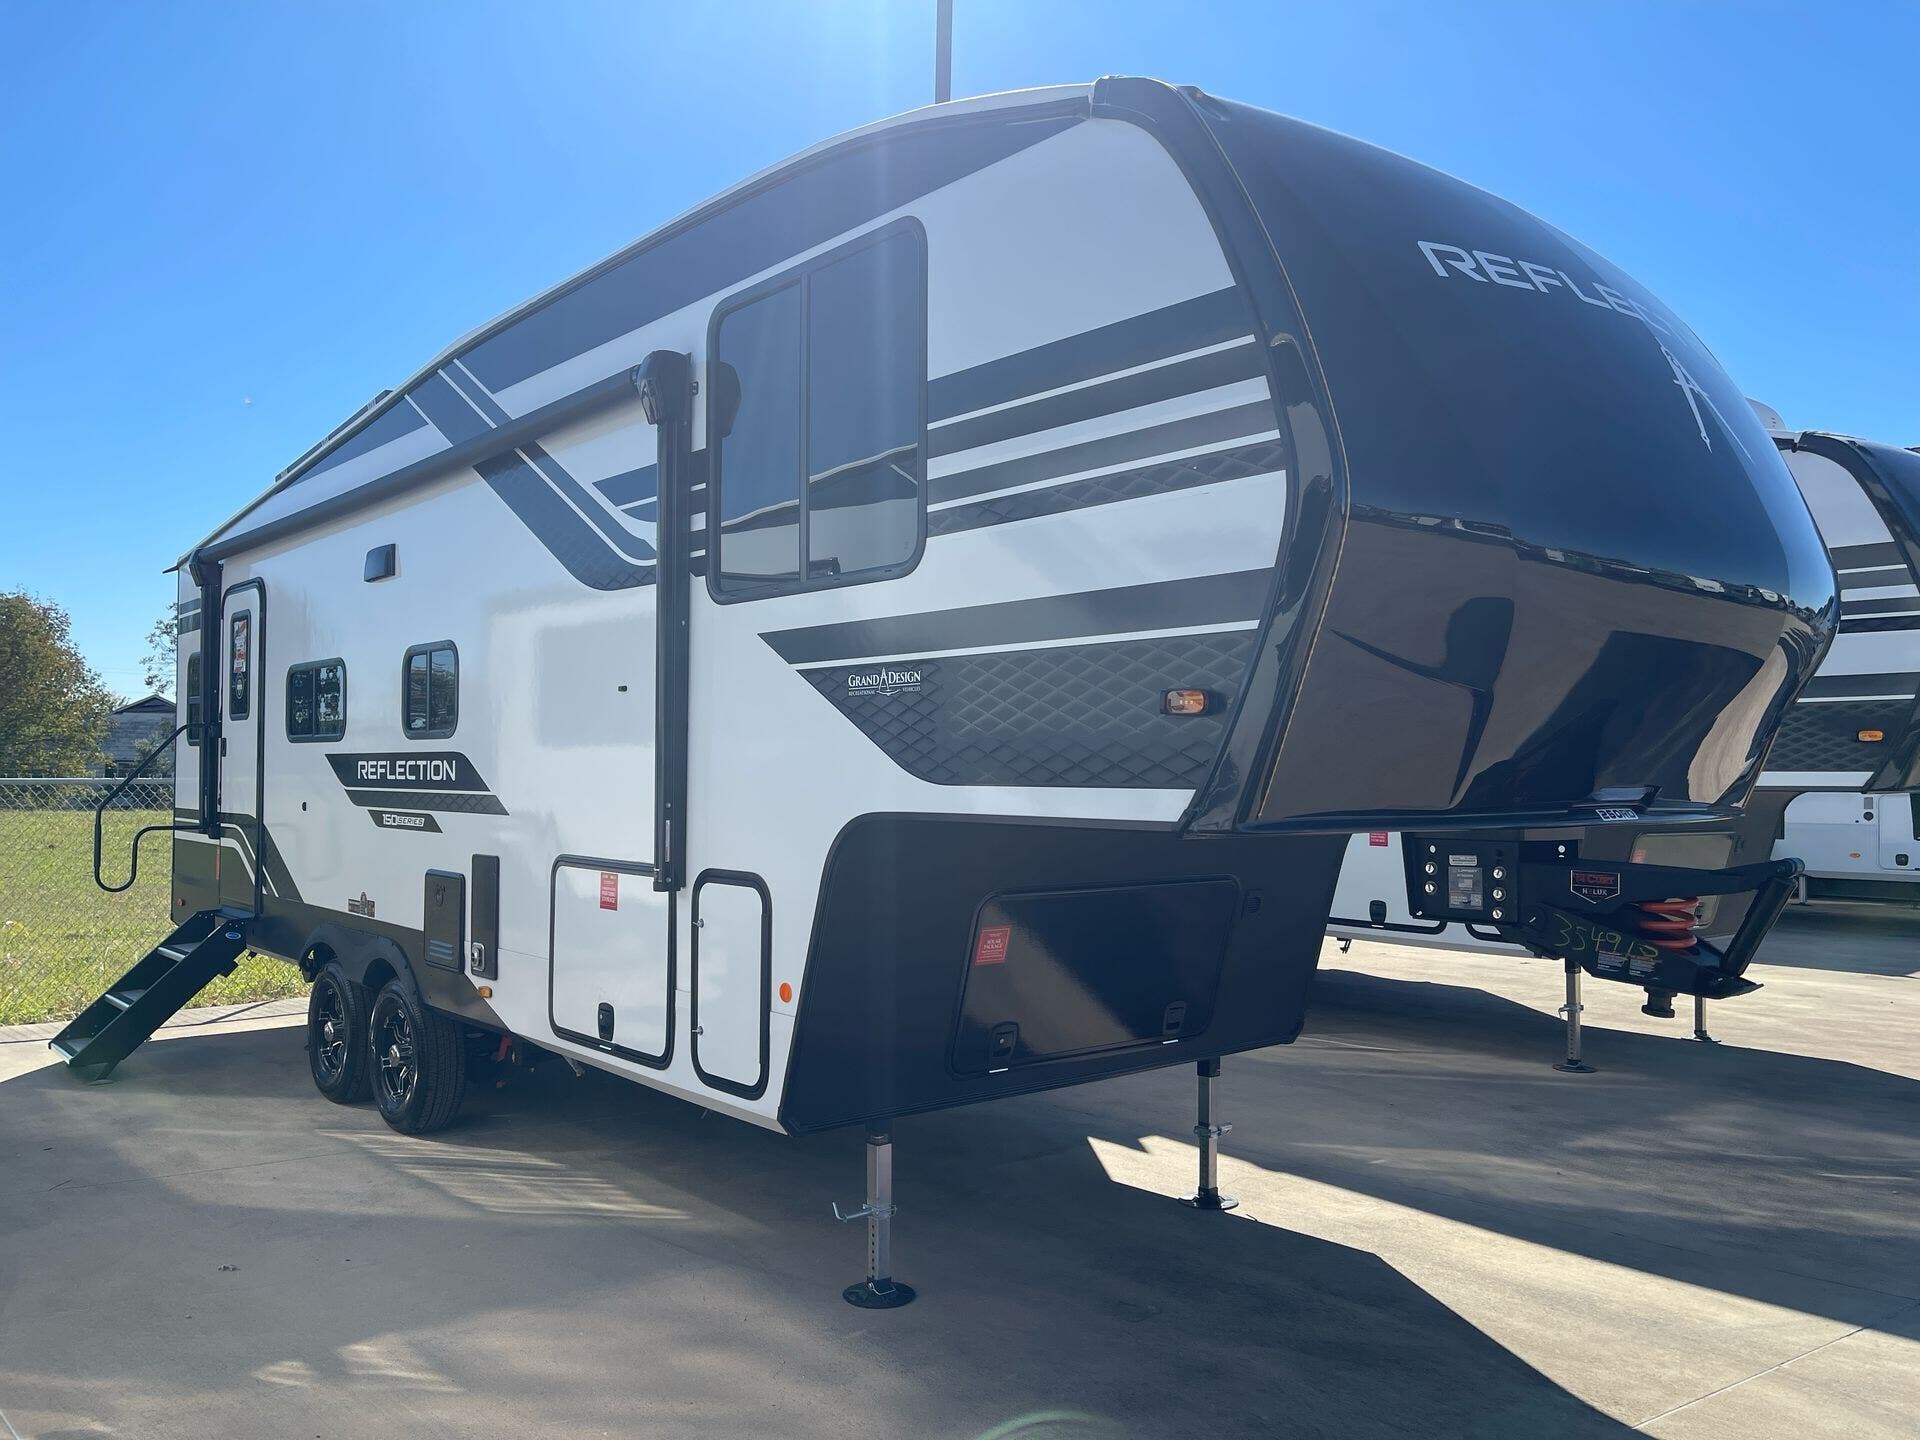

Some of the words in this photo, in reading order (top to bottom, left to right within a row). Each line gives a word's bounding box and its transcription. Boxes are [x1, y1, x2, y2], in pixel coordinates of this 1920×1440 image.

[848, 675, 880, 687] GRAND
[888, 671, 921, 684] DESIGN
[357, 760, 456, 781] REFLECTION
[398, 816, 424, 826] SERIES
